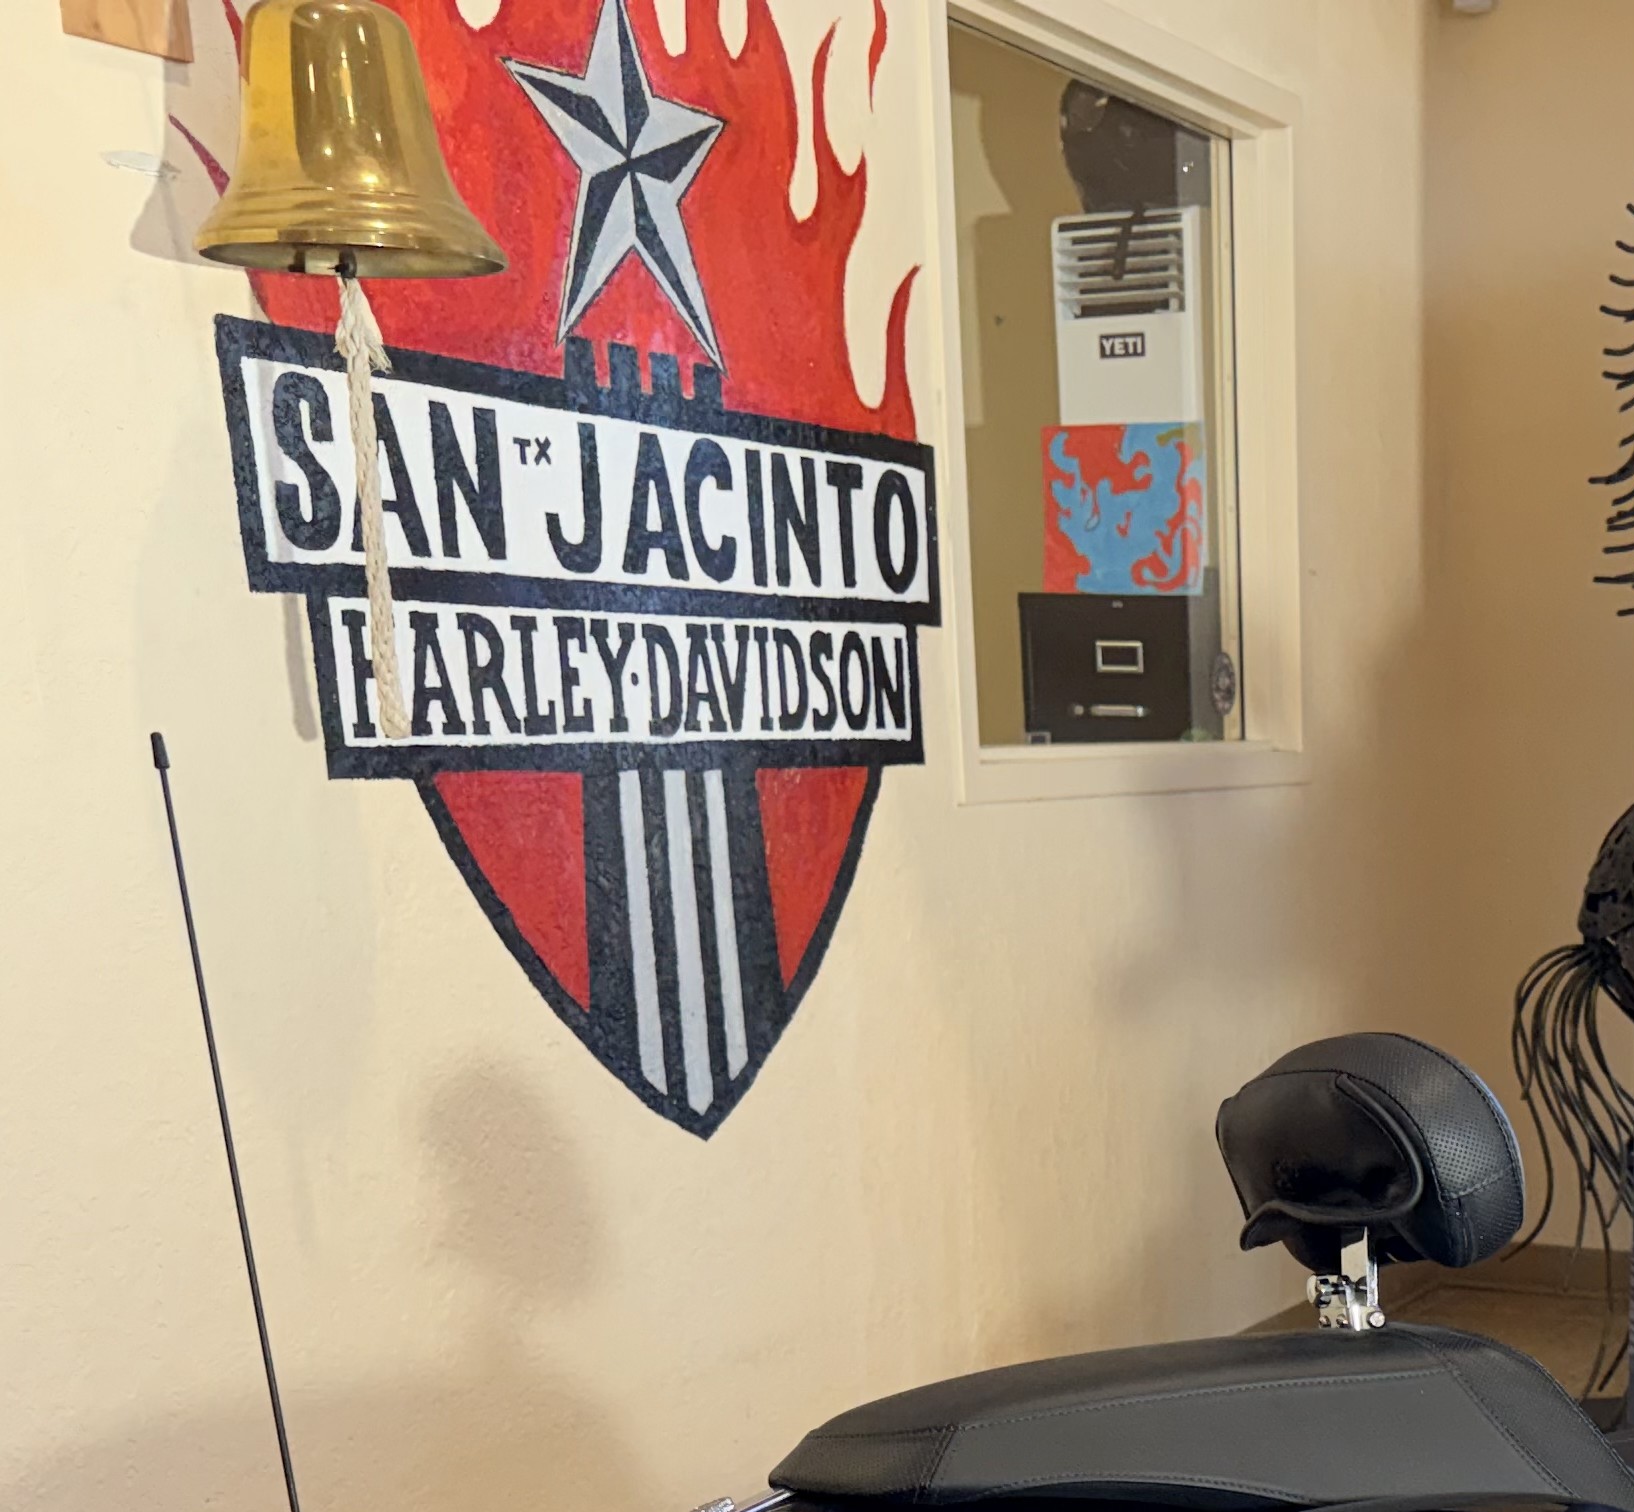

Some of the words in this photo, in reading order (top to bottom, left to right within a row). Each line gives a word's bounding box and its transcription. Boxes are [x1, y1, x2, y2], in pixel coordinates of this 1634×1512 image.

[1101, 336, 1143, 355] YETI
[273, 371, 507, 560] SAN
[513, 436, 552, 466] TX
[545, 421, 918, 594] JACINTO
